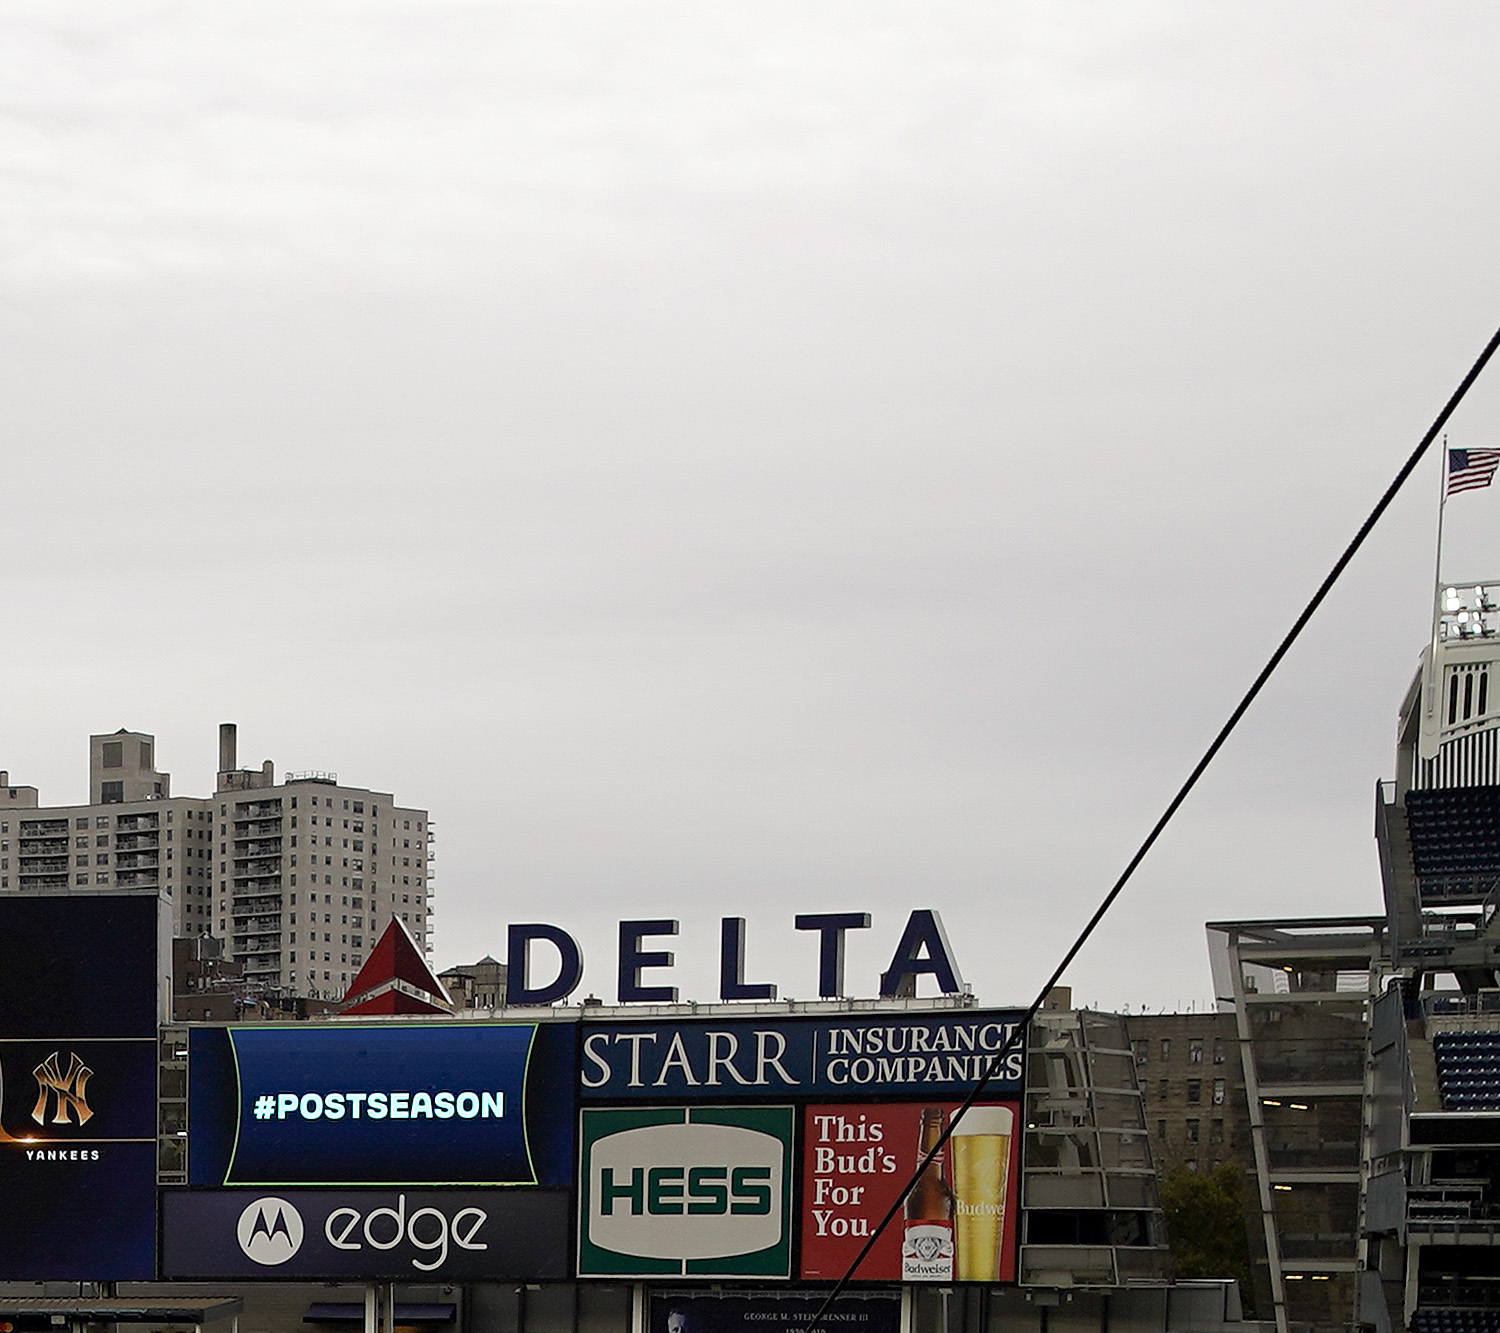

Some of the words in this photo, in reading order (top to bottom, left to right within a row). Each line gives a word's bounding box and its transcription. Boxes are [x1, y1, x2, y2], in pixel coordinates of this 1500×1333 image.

[508, 909, 966, 1003] DELTA
[827, 1022, 1023, 1054] INSURANCE
[581, 1031, 801, 1088] STARR
[827, 1054, 1023, 1083] COMPANIES
[254, 1091, 505, 1120] #POSTSEASON
[813, 1115, 885, 1143] This
[25, 1150, 99, 1161] YANKEES
[813, 1147, 898, 1176] Bud's
[602, 1167, 772, 1216] HESS
[812, 1179, 866, 1206] For
[325, 1195, 488, 1271] edge
[811, 1209, 878, 1238] You.
[744, 1312, 779, 1321] GEORGE
